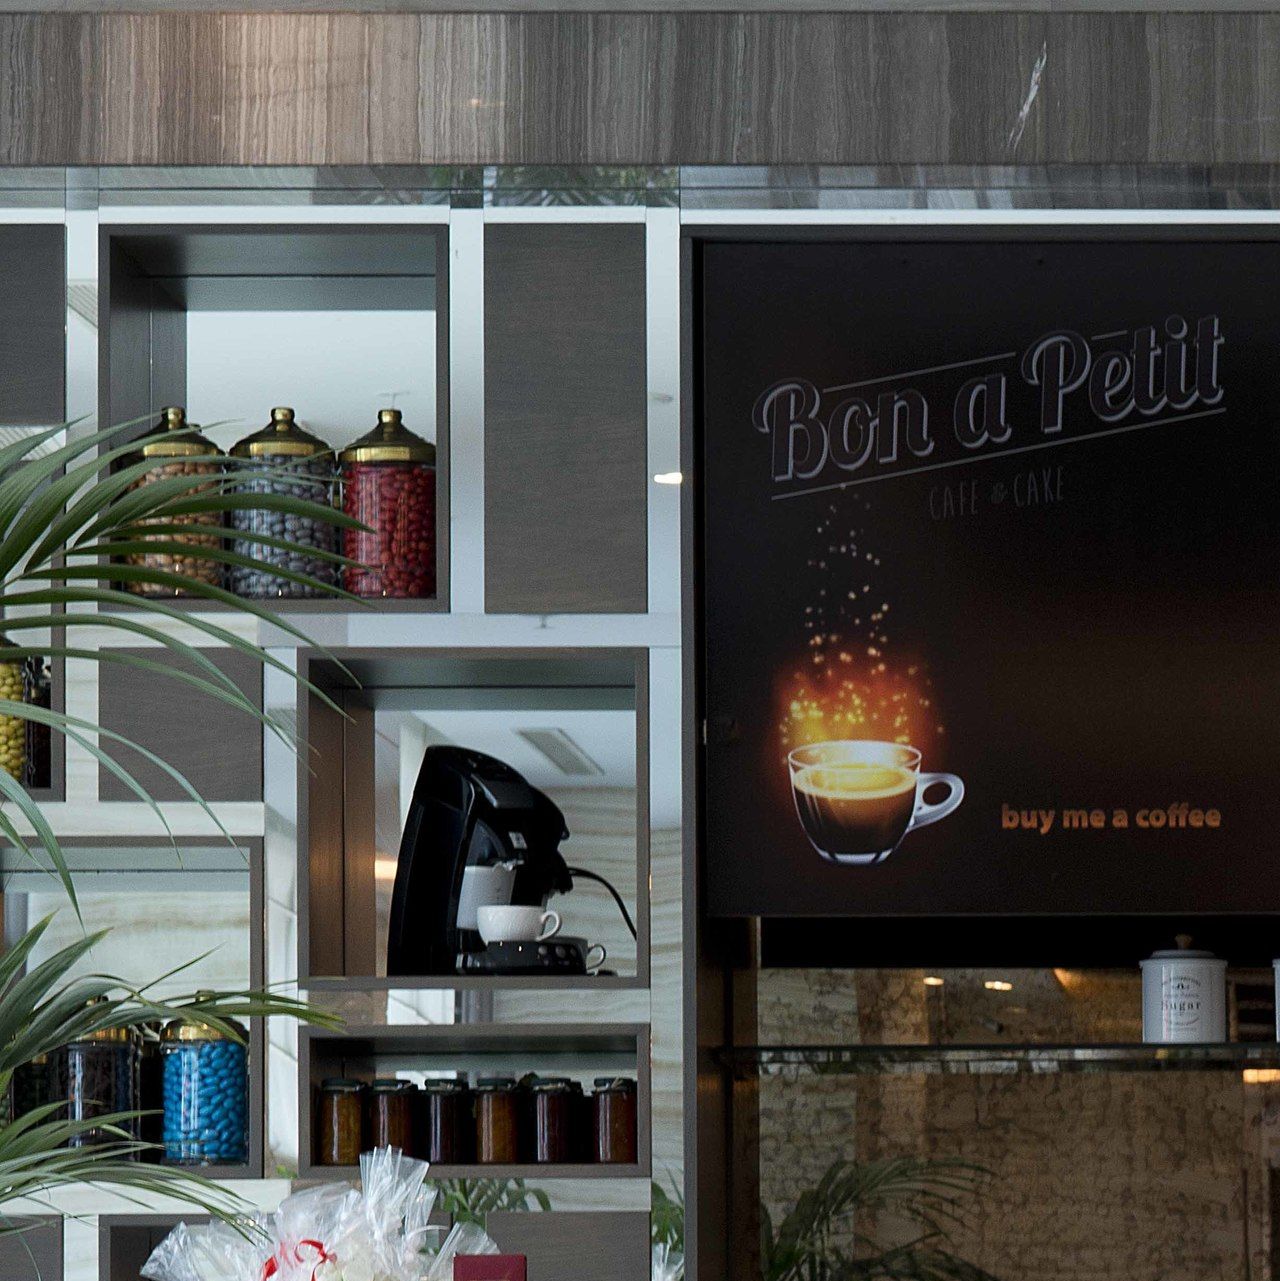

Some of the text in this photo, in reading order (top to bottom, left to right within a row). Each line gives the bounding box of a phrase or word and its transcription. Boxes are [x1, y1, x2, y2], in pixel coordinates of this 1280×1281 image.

[752, 314, 1226, 483] Bon a Petit
[1013, 465, 1065, 507] CAKE
[1001, 802, 1222, 836] buy me a coffee
